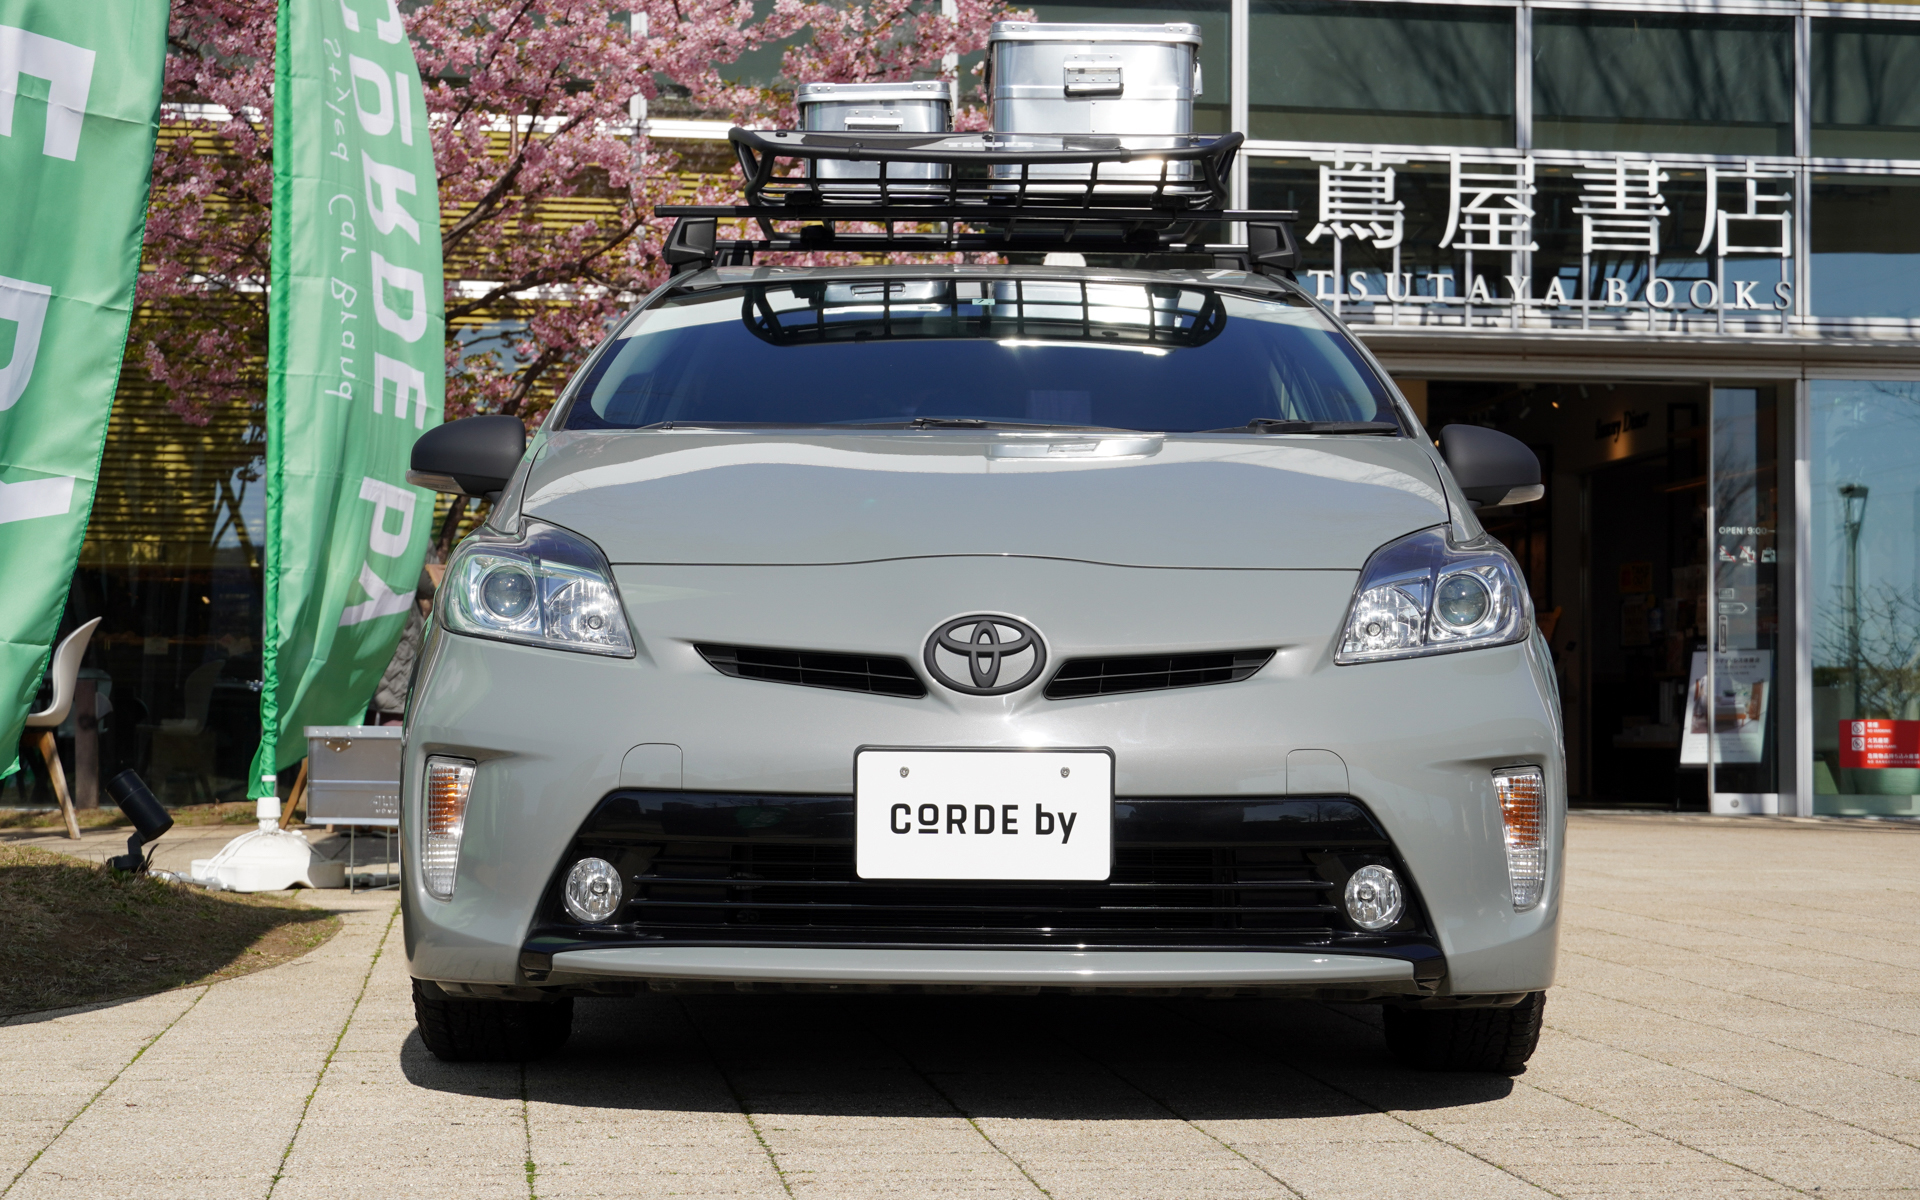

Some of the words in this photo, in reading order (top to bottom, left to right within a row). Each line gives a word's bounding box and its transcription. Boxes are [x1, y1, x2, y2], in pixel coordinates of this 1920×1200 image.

[1305, 149, 1794, 257] 蔦屋書店
[1306, 270, 1570, 306] TSUTAYA
[1604, 276, 1793, 311] BOOKS
[1718, 526, 1744, 535] OPEN
[890, 803, 1019, 835] CORDE
[1035, 803, 1077, 844] by
